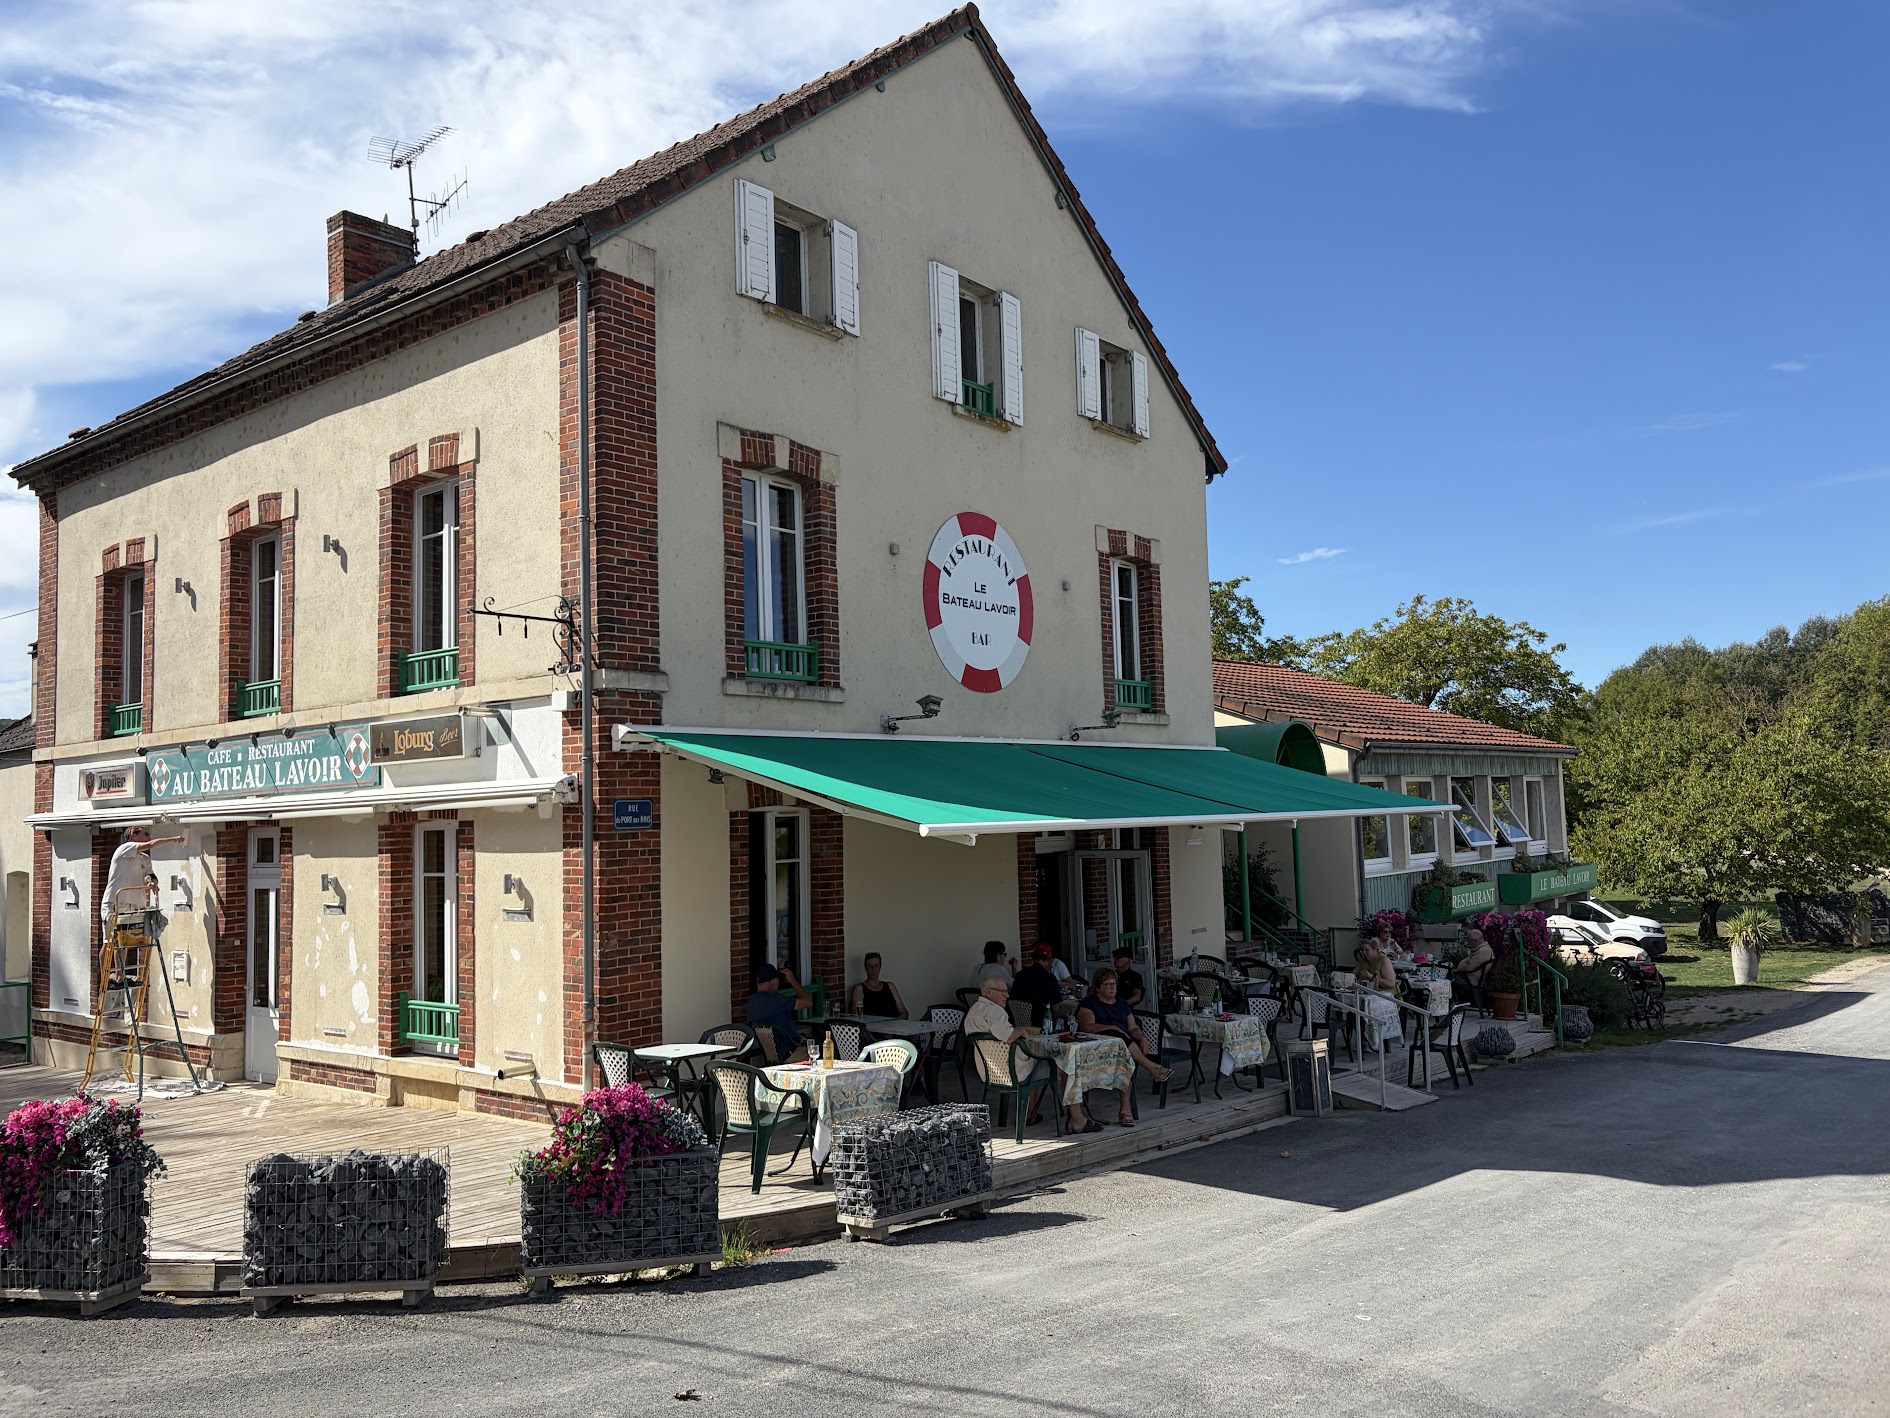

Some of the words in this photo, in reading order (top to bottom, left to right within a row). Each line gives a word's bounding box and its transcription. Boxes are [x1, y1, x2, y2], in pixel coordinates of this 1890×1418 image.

[942, 540, 1016, 586] RESTAURANT
[974, 582, 987, 594] LE
[942, 592, 982, 611] BATEAU
[984, 602, 1017, 616] LAVOIR
[971, 631, 992, 646] BAR
[207, 749, 232, 765] CAFE
[248, 739, 315, 761] RESTAURANT
[393, 728, 434, 755] Loburg
[97, 773, 126, 792] Jupiler
[171, 771, 194, 796] AU
[200, 763, 267, 793] BATEAU
[275, 755, 343, 785] LAVOIR
[620, 815, 632, 824] PORT
[640, 815, 651, 824] BOIS
[1540, 878, 1548, 891] LE
[1551, 873, 1571, 889] BATEAU
[1573, 871, 1590, 884] LAVOIR
[1452, 888, 1496, 909] RESTAURANT
